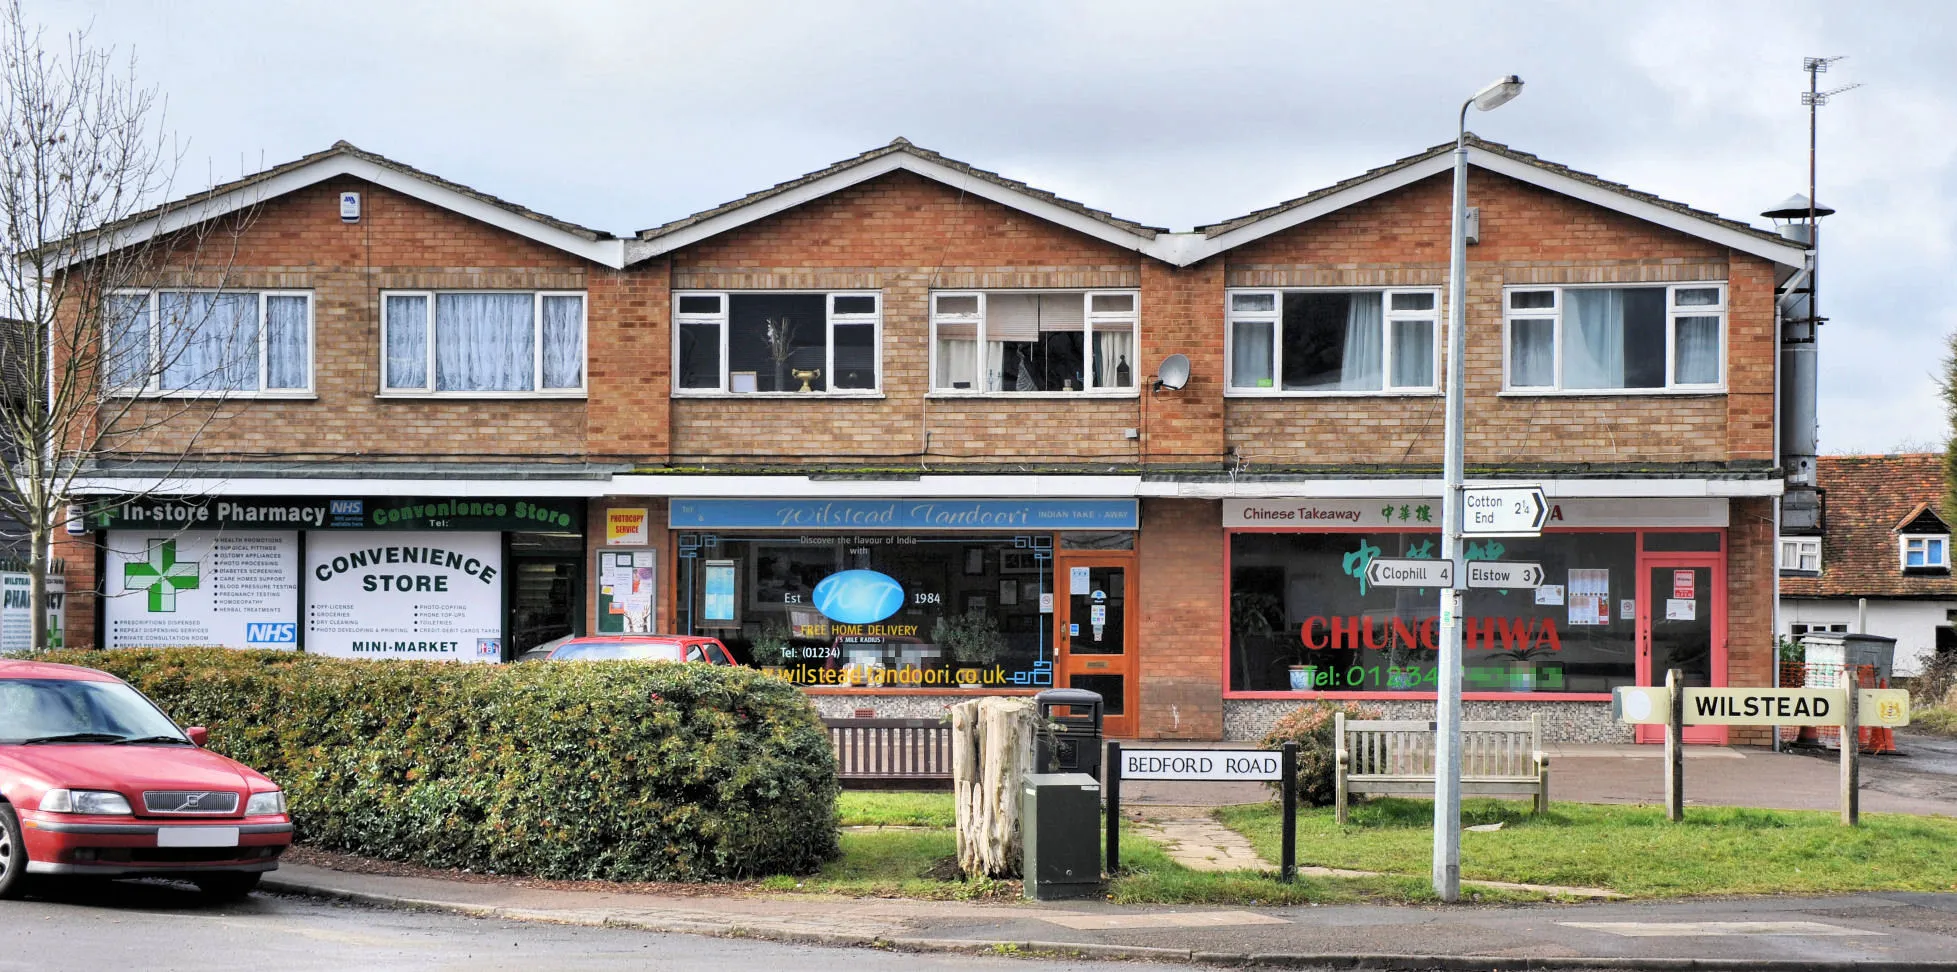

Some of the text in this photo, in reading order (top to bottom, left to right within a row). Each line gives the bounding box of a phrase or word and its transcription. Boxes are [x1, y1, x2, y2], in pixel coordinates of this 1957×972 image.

[332, 502, 361, 513] NHS
[1467, 495, 1503, 508] Cotton
[123, 502, 326, 527] In-store Pharmacy
[372, 499, 571, 527] Convenience Store
[611, 514, 644, 523] PHOTOCOPY
[776, 503, 1030, 525] Wilstead Tandoori
[1038, 511, 1069, 519] INDIAN
[1072, 511, 1095, 519] TAKE
[1103, 511, 1128, 519] AWAY
[1243, 507, 1361, 522] Chinese Takeaway
[1381, 504, 1433, 523] 中華樓
[1475, 512, 1494, 524] End
[429, 519, 449, 527] Tel:
[615, 525, 639, 534] SERVICE
[801, 535, 917, 545] Discover the flavour of India
[849, 547, 868, 555] with
[315, 546, 497, 585] CONVENIENCE
[1382, 566, 1449, 583] Clophill 4
[1472, 568, 1531, 581] Elstow 3
[362, 574, 449, 592] STORE
[784, 592, 941, 604] Est 1984
[247, 624, 294, 641] NHS
[800, 624, 918, 636] FREE HOME DELIVERY
[1300, 615, 1562, 650] CHUNG HWA
[352, 641, 459, 652] MINI-MARKET
[781, 648, 797, 658] Tel:
[802, 647, 840, 659] (01234)
[1306, 666, 1341, 687] Tel:
[1347, 666, 1439, 687] 01234
[1695, 696, 1830, 717] WILSTEAD
[1128, 757, 1277, 774] BEDFORD ROAD
